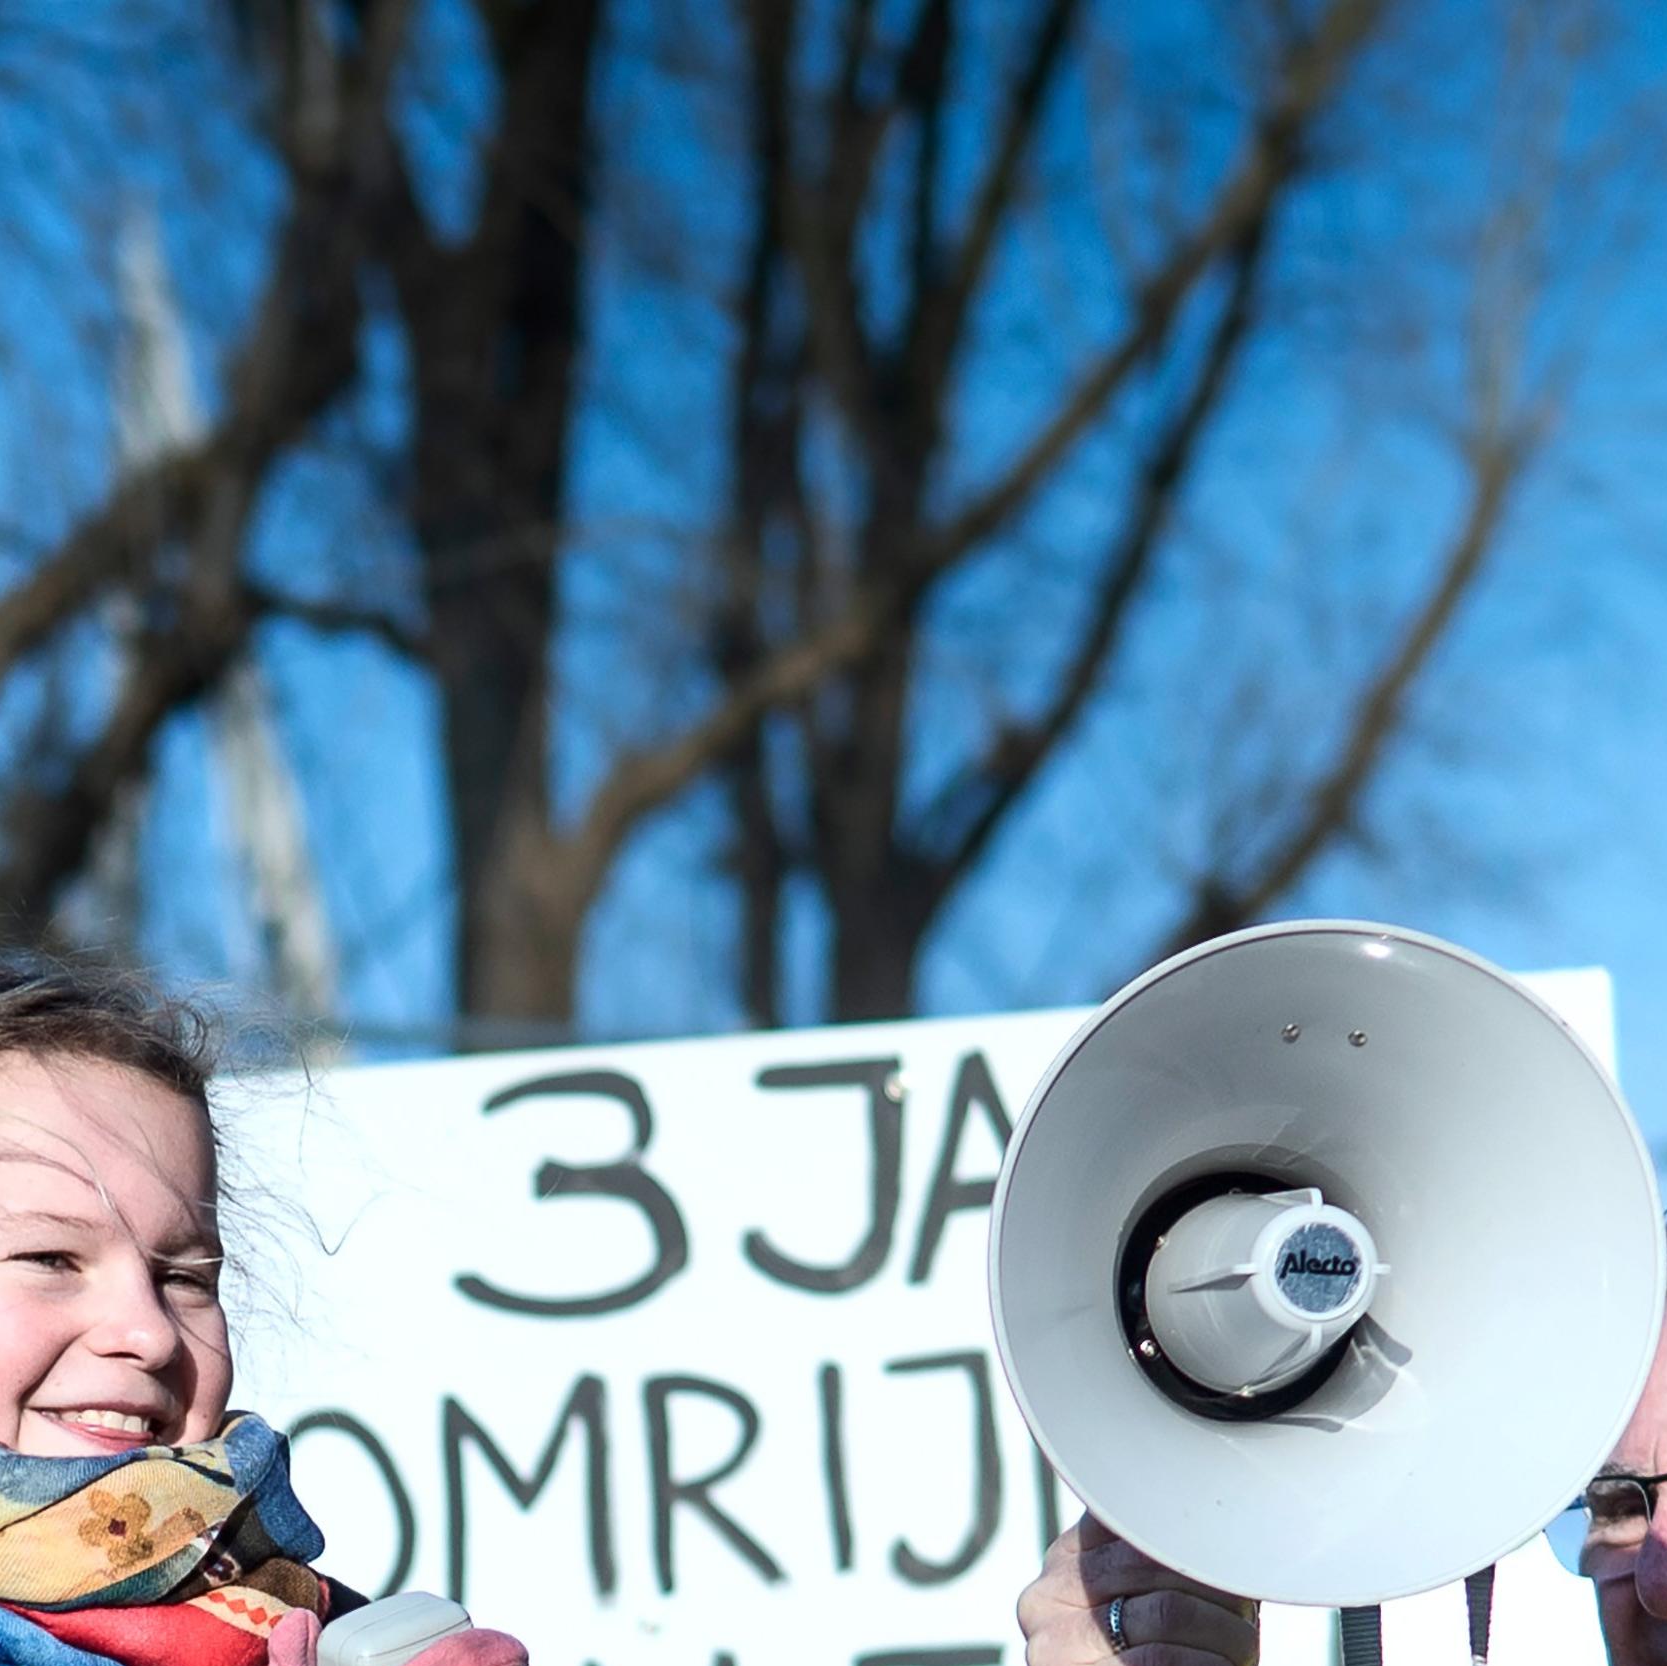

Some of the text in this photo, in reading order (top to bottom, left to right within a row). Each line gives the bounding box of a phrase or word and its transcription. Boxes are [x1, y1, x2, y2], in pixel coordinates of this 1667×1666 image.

[453, 1063, 692, 1319] 3
[1278, 1250, 1359, 1278] Alecto
[287, 1347, 1060, 1607] OMRIJ
